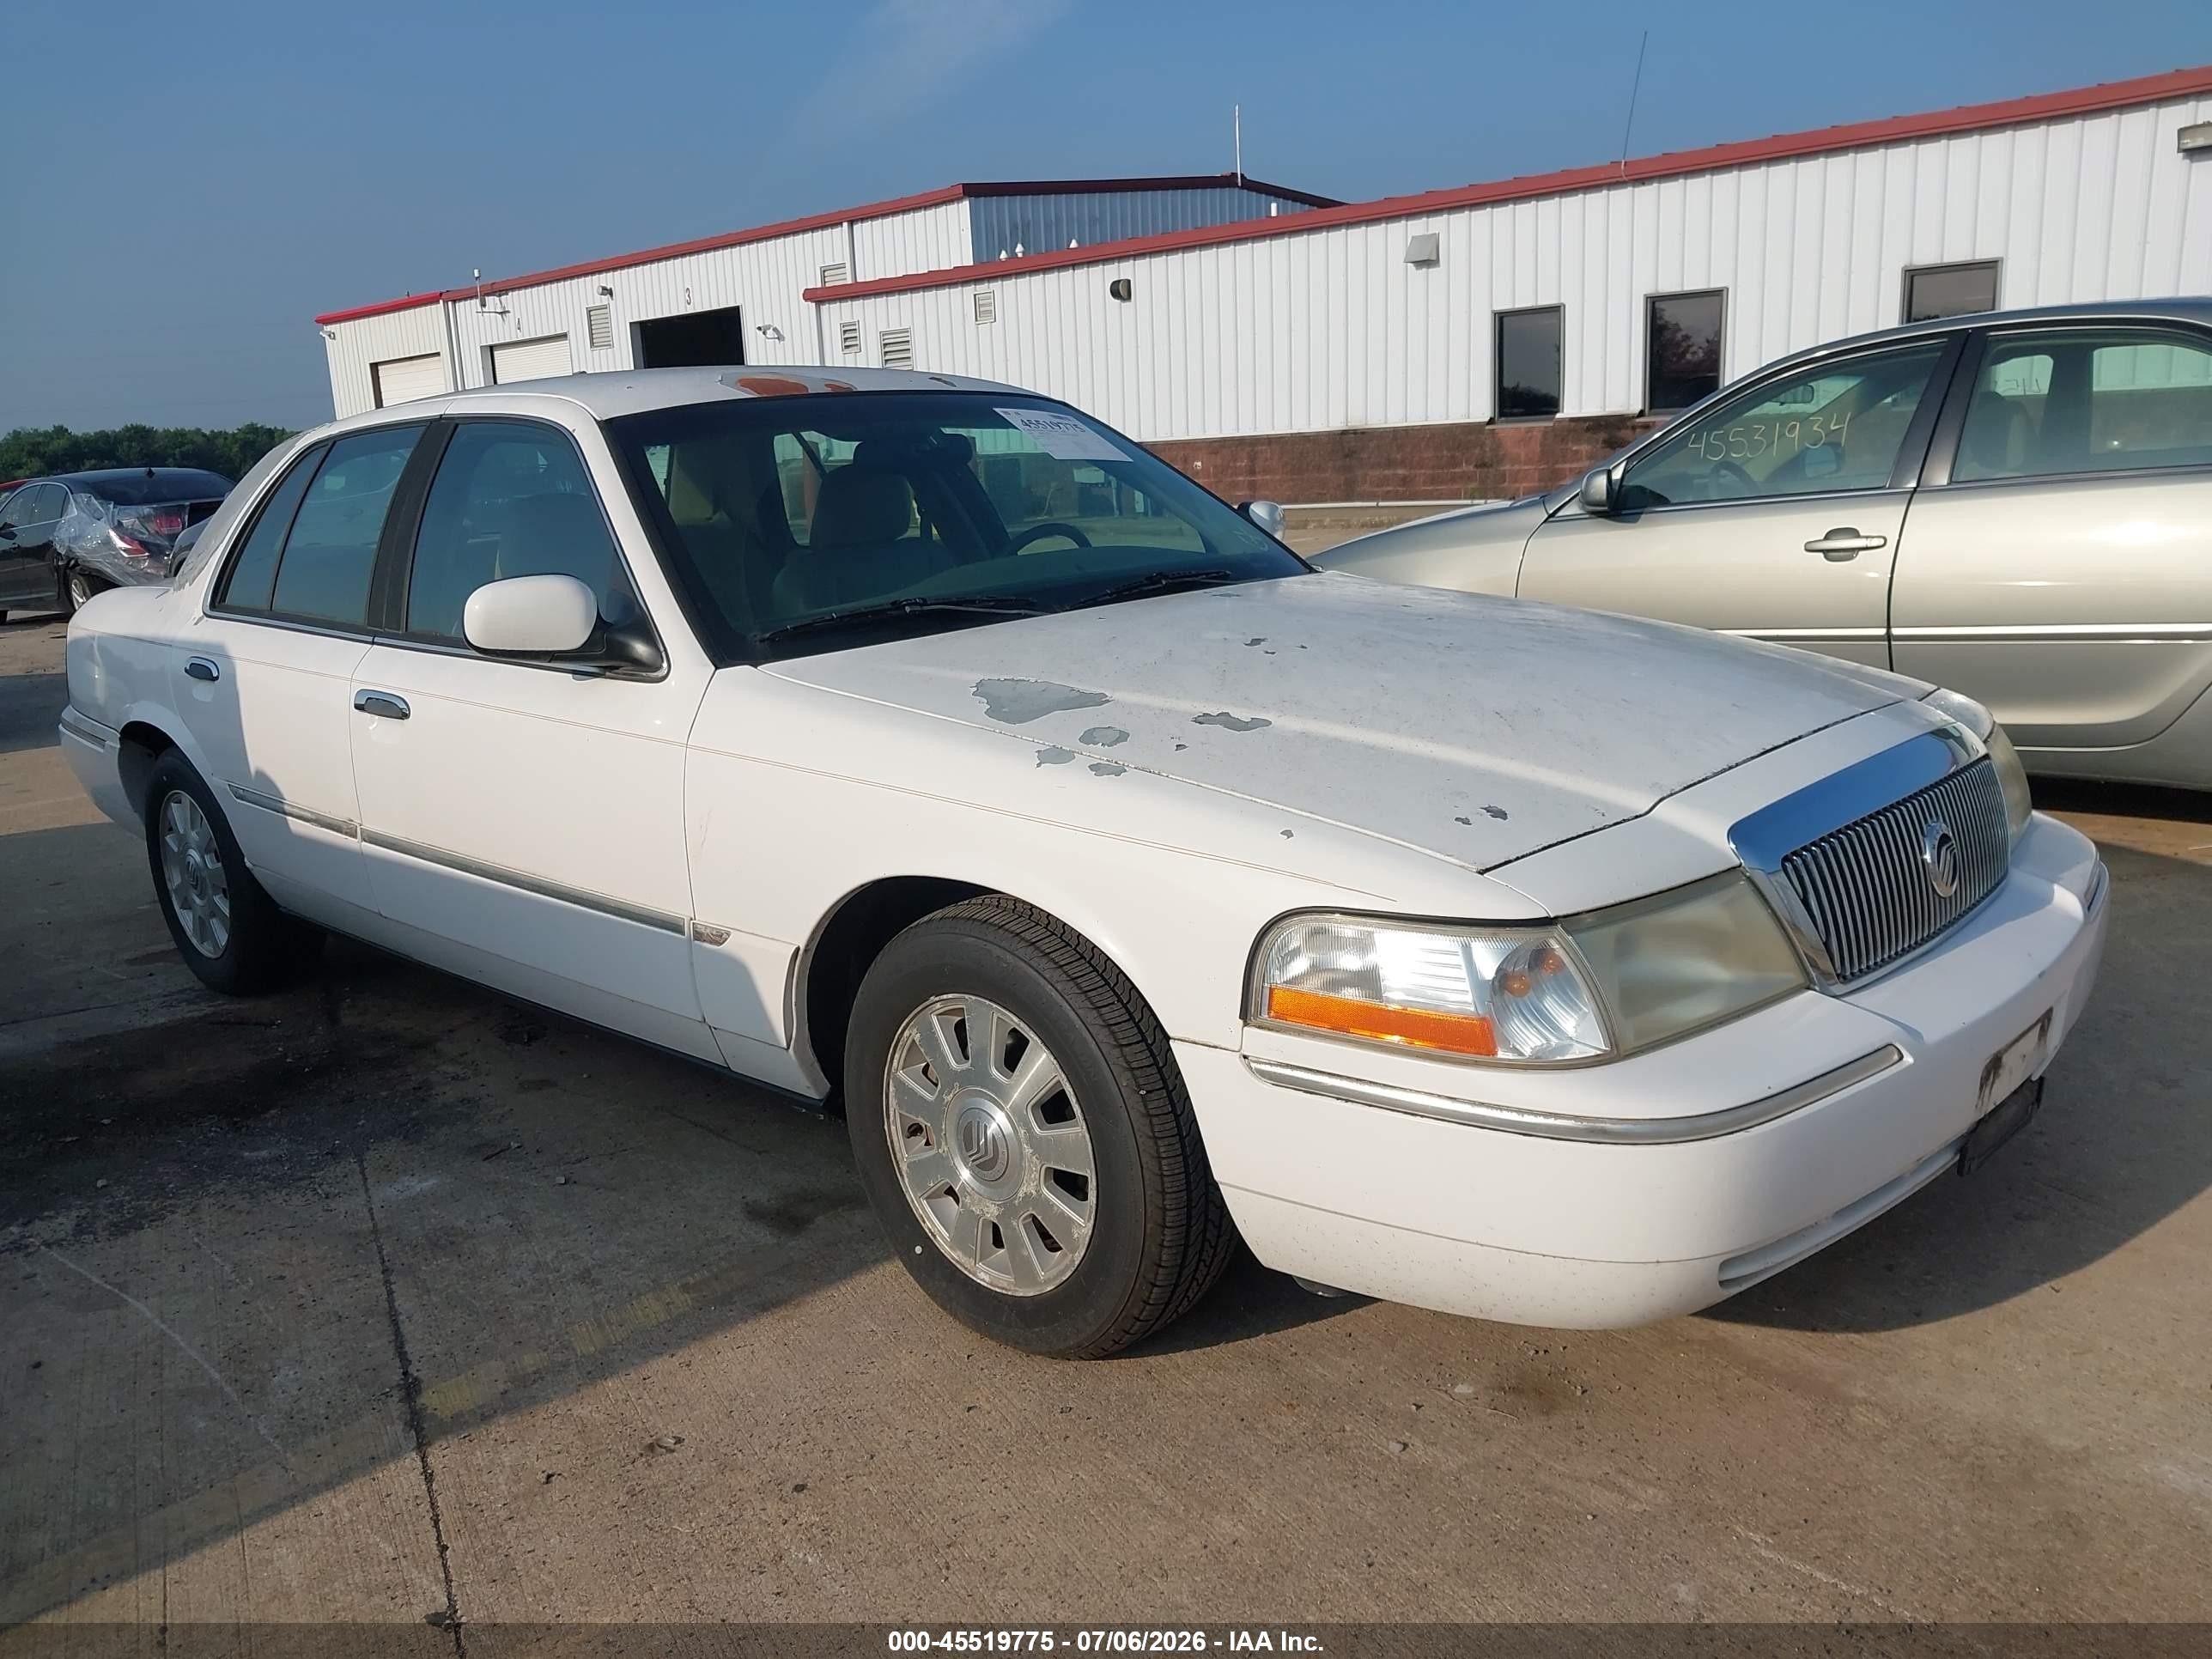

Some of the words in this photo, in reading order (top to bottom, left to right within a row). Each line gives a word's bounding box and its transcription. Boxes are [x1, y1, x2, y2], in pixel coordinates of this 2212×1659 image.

[685, 287, 691, 305] 3
[1020, 418, 1086, 433] 45519775
[1688, 412, 1851, 460] 45531934
